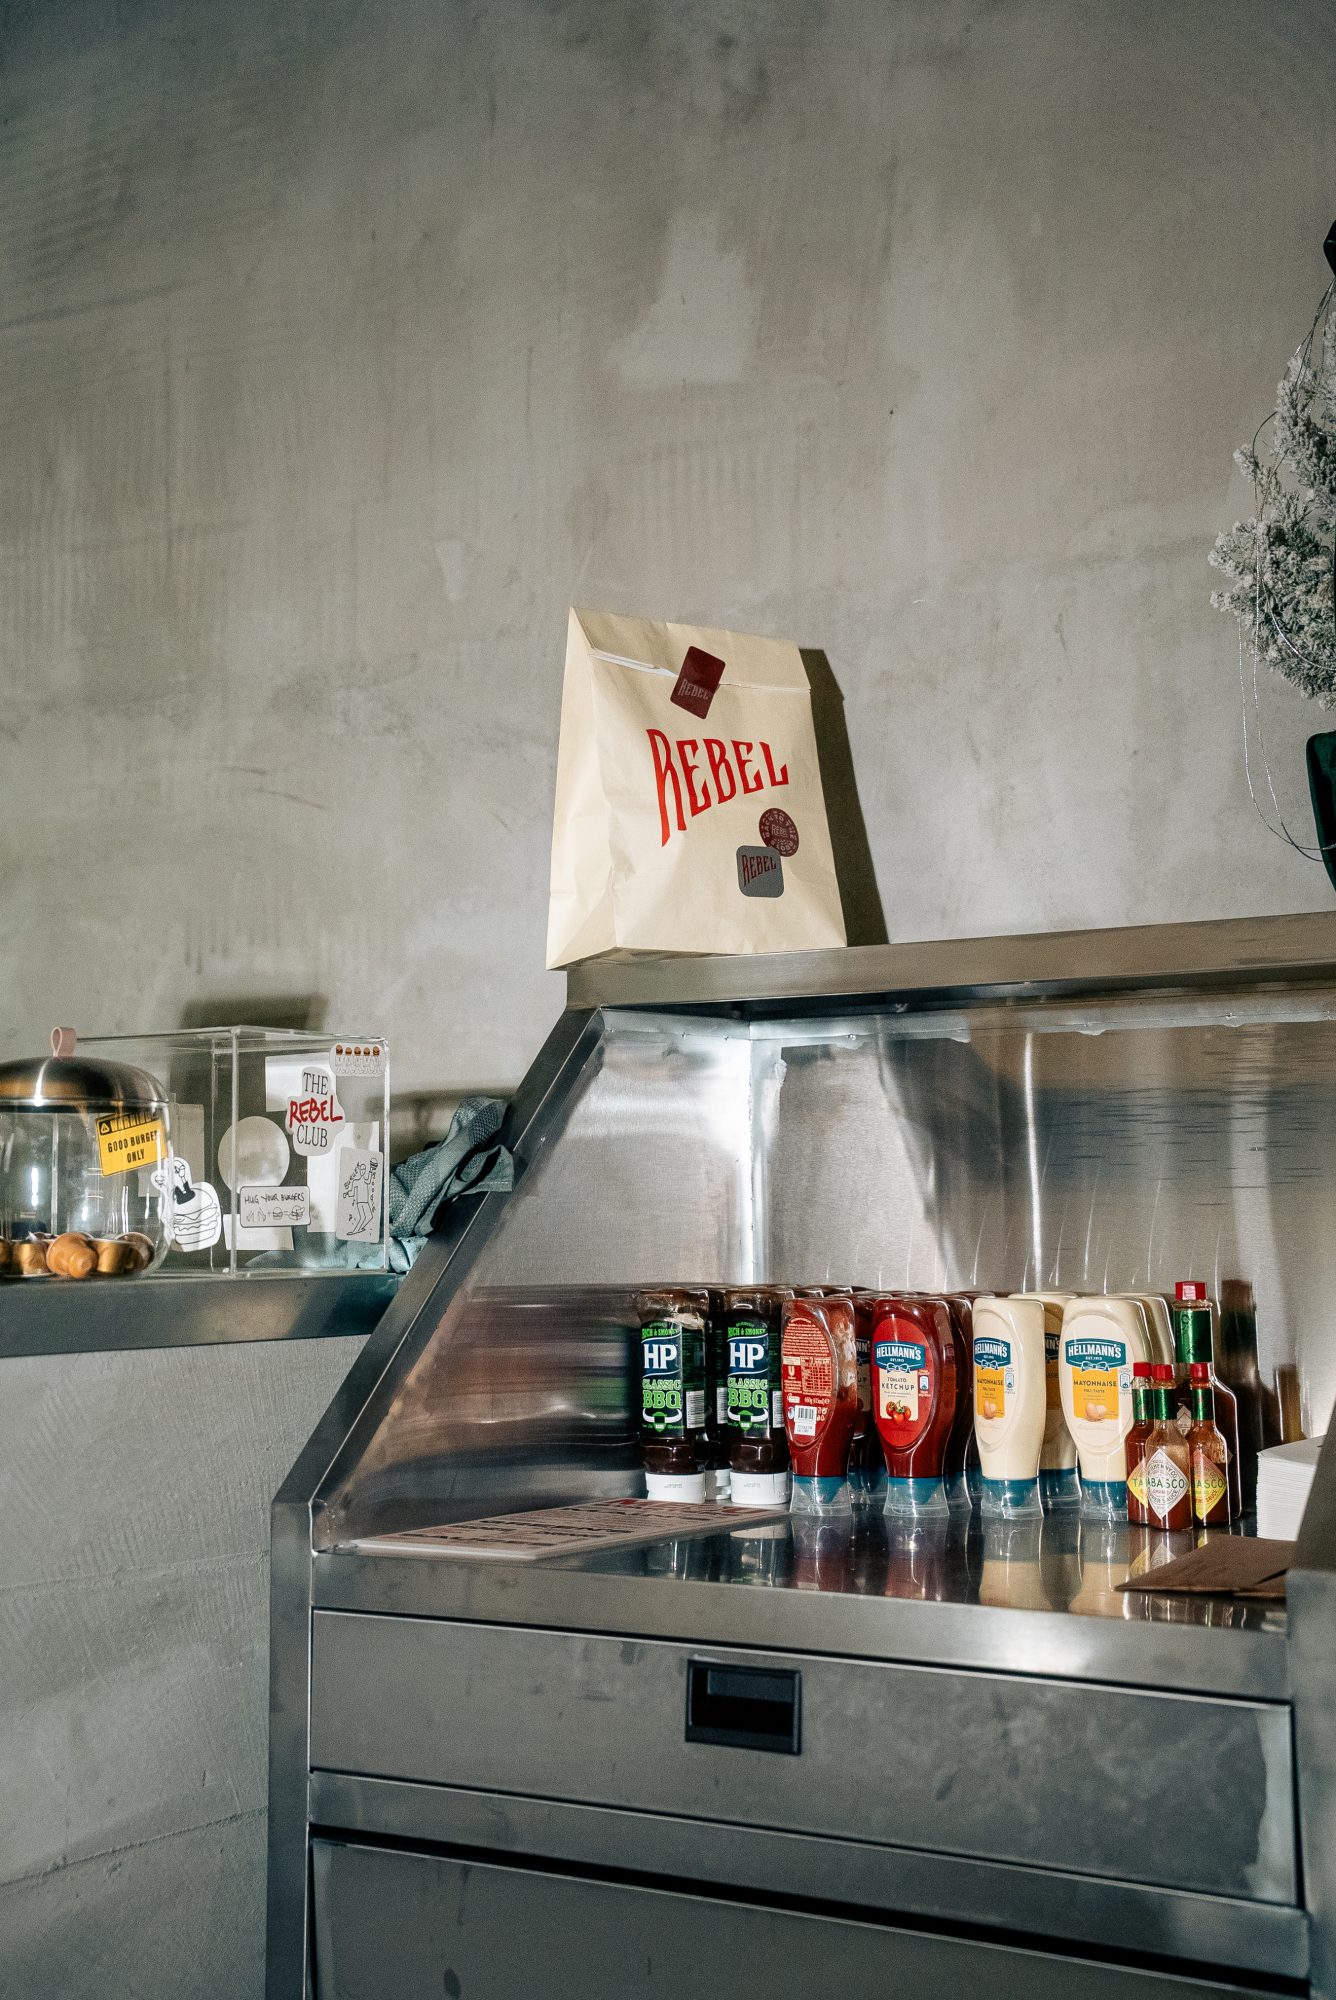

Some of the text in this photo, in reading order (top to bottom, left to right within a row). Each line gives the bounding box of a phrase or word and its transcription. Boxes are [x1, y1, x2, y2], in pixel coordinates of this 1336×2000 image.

[677, 678, 709, 700] REBEL
[646, 728, 789, 847] REBEL
[741, 854, 777, 888] REBEL
[303, 1072, 329, 1096] THE
[289, 1094, 343, 1129] REBEL
[107, 1138, 129, 1153] GOOD
[296, 1124, 328, 1148] CLUB
[126, 1148, 145, 1163] ONLY
[244, 1194, 260, 1205] HUG
[644, 1343, 678, 1369] HP
[730, 1342, 765, 1368] HP
[876, 1345, 922, 1361] HELLMANN'S
[975, 1342, 1008, 1358] HELLMANN'S
[1068, 1343, 1122, 1359] HELLMANN'S
[642, 1379, 682, 1390] CLASSIC
[727, 1377, 769, 1390] CLASSIC
[881, 1382, 915, 1391] KETCHUP
[642, 1390, 682, 1409] BBQ
[728, 1388, 769, 1408] BBQ
